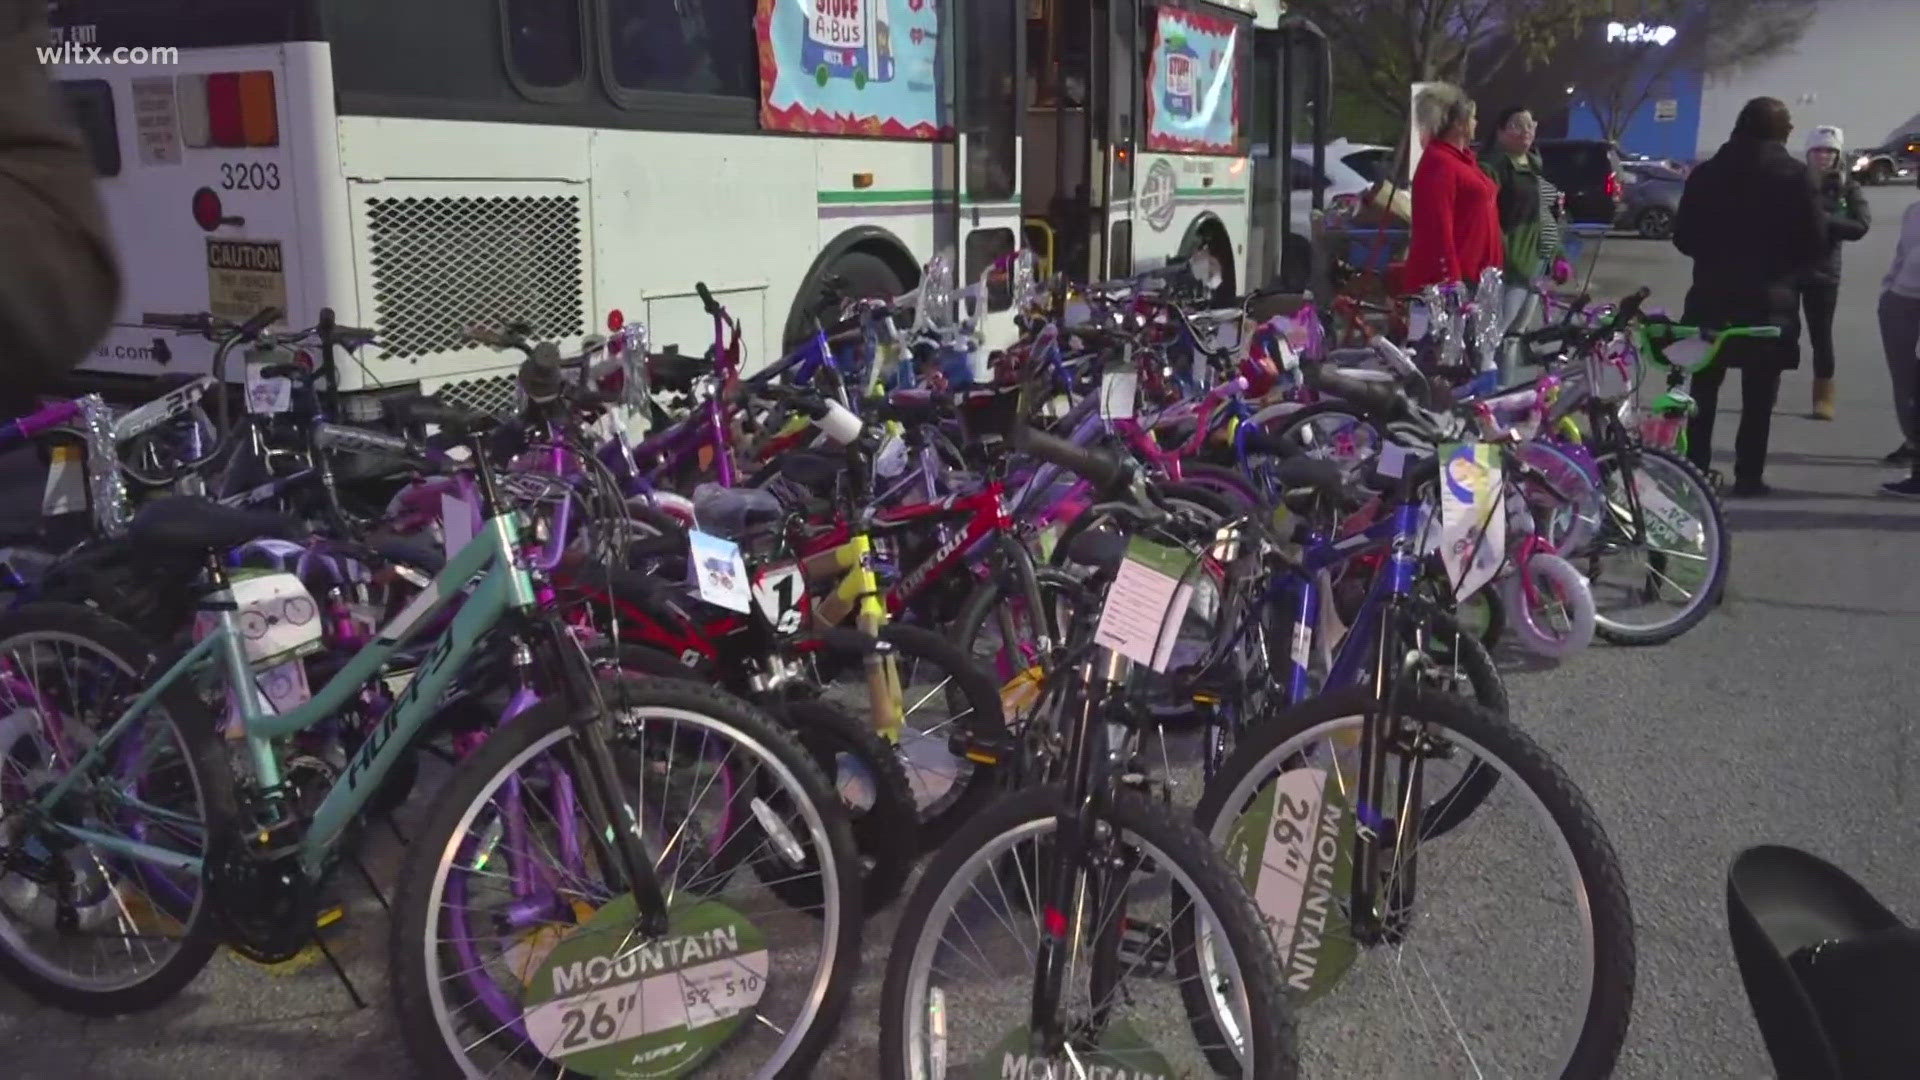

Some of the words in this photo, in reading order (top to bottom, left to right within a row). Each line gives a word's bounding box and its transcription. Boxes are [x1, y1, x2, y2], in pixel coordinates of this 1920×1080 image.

[220, 162, 281, 190] 3203
[210, 244, 280, 270] CAUTION
[772, 574, 794, 612] 1
[347, 624, 454, 791] HUFFY
[1273, 792, 1310, 873] 26"
[1287, 803, 1343, 992] MOUNTAIN
[552, 924, 738, 995] MOUNTAIN
[561, 994, 637, 1050] 26"
